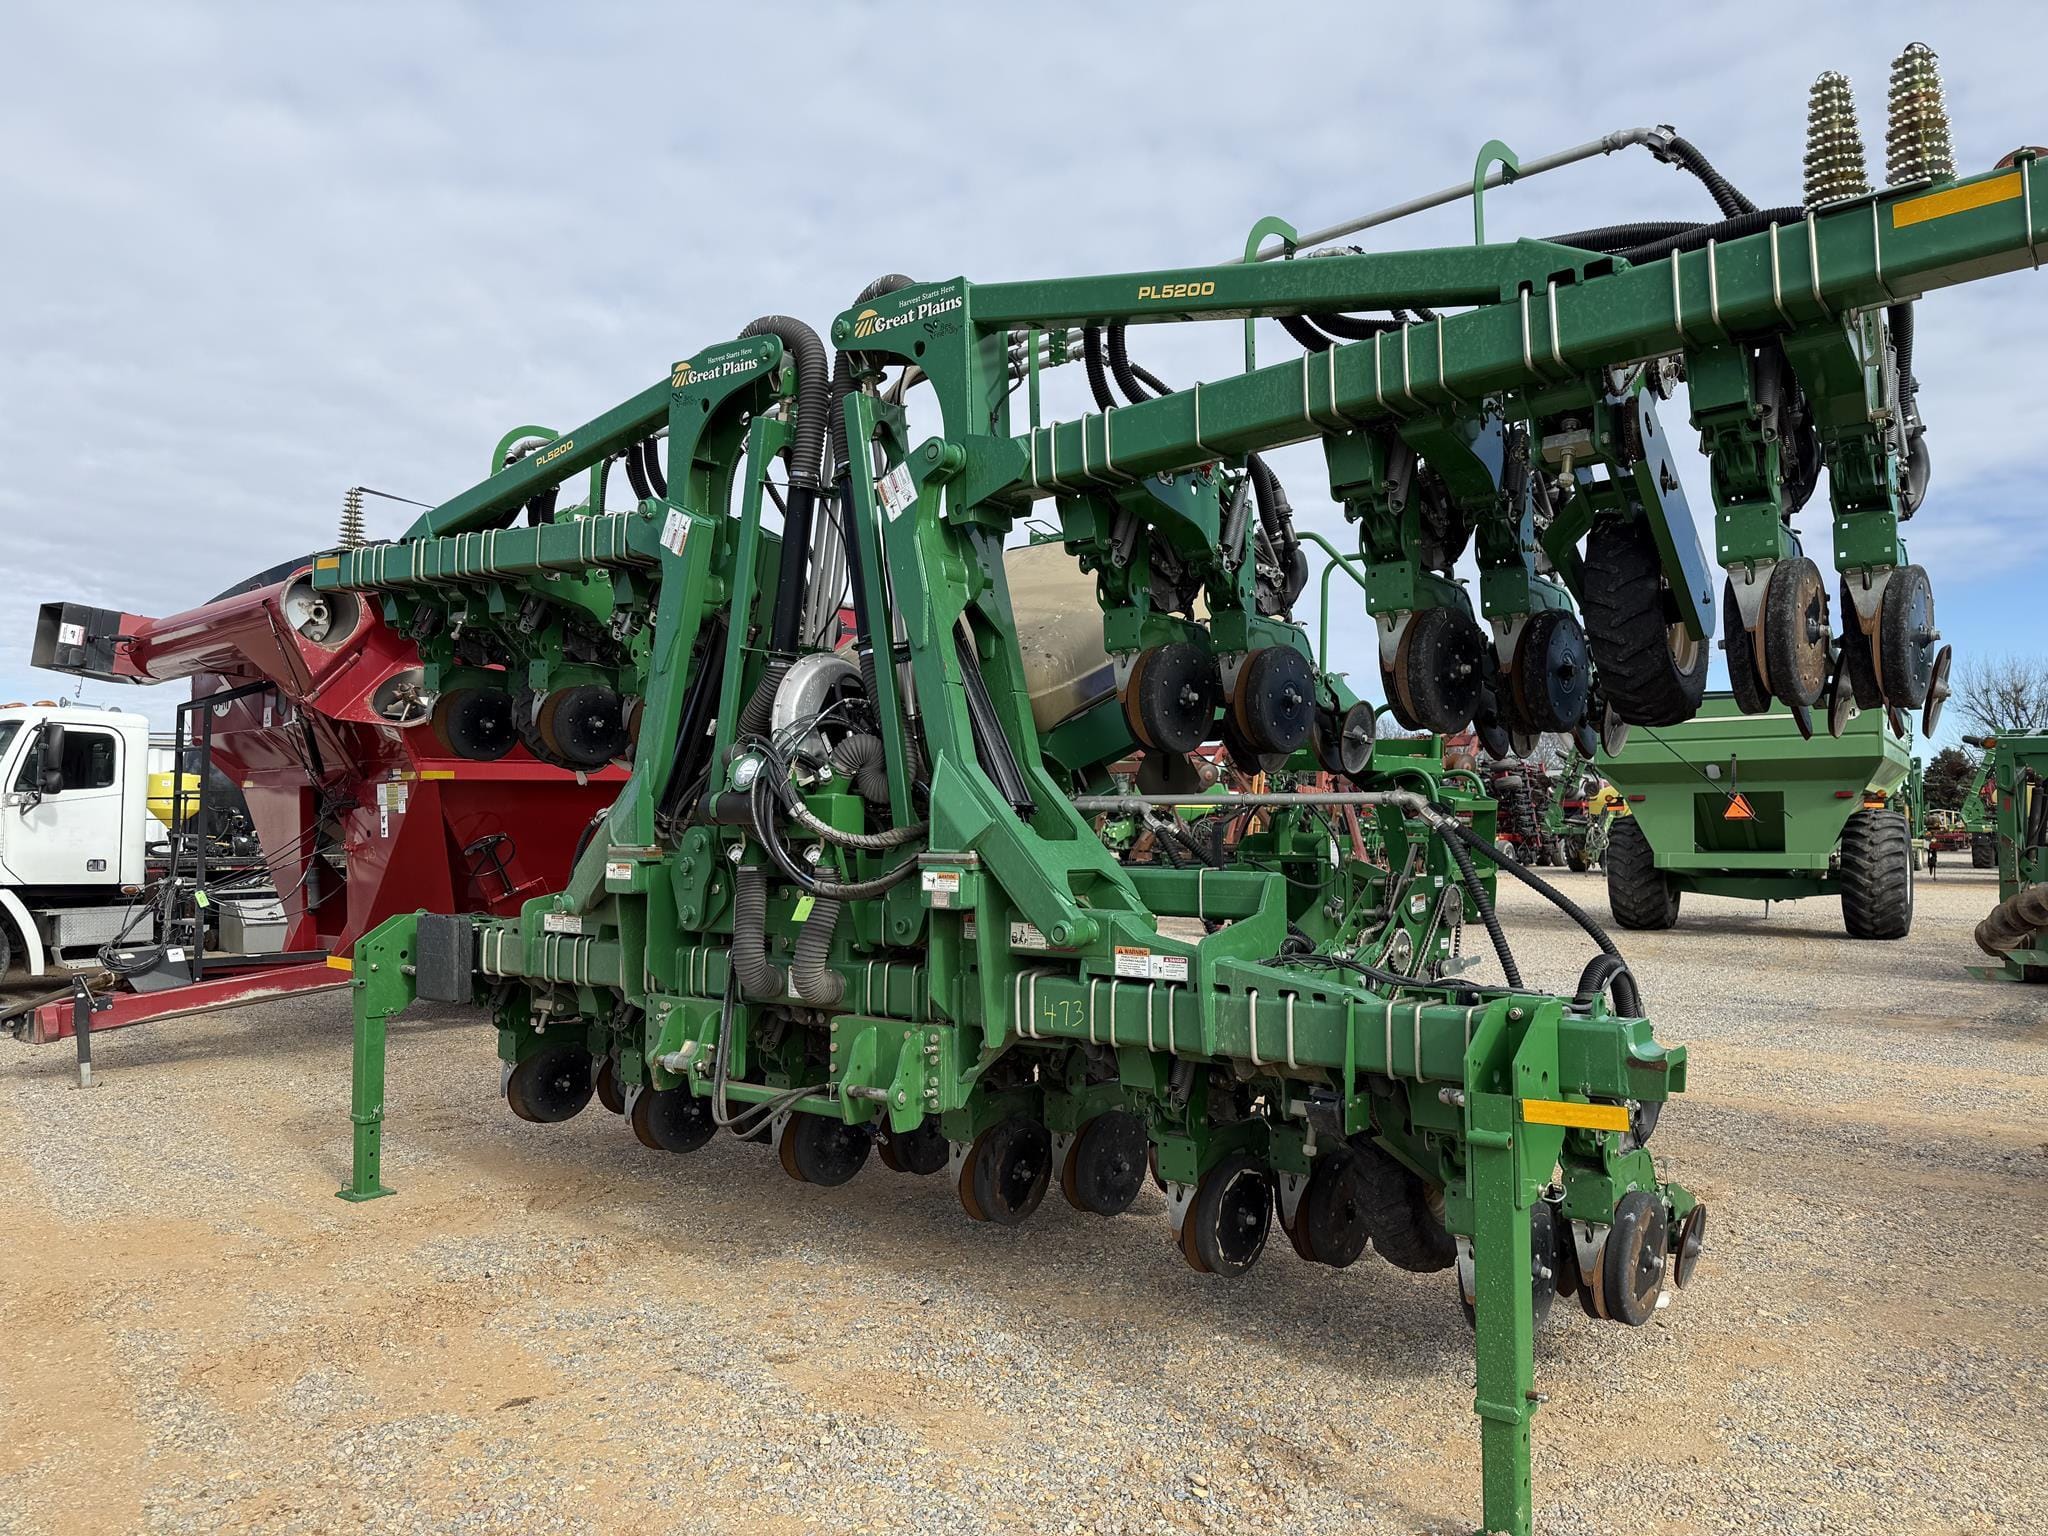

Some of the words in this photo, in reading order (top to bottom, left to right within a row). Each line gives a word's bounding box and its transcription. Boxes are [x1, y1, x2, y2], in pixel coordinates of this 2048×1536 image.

[898, 296, 921, 308] Harvest
[922, 290, 939, 301] Starts
[940, 285, 955, 295] Here
[1138, 281, 1215, 300] PL5200
[874, 308, 916, 333] Great
[917, 296, 963, 320] Plains
[707, 355, 725, 364] Harvest
[726, 351, 740, 361] Starts
[740, 348, 753, 356] Here
[688, 365, 720, 385] Great
[722, 358, 758, 377] Plains
[536, 440, 574, 468] PL5200
[1124, 948, 1148, 956] WARNING
[1043, 995, 1085, 1029] 473
